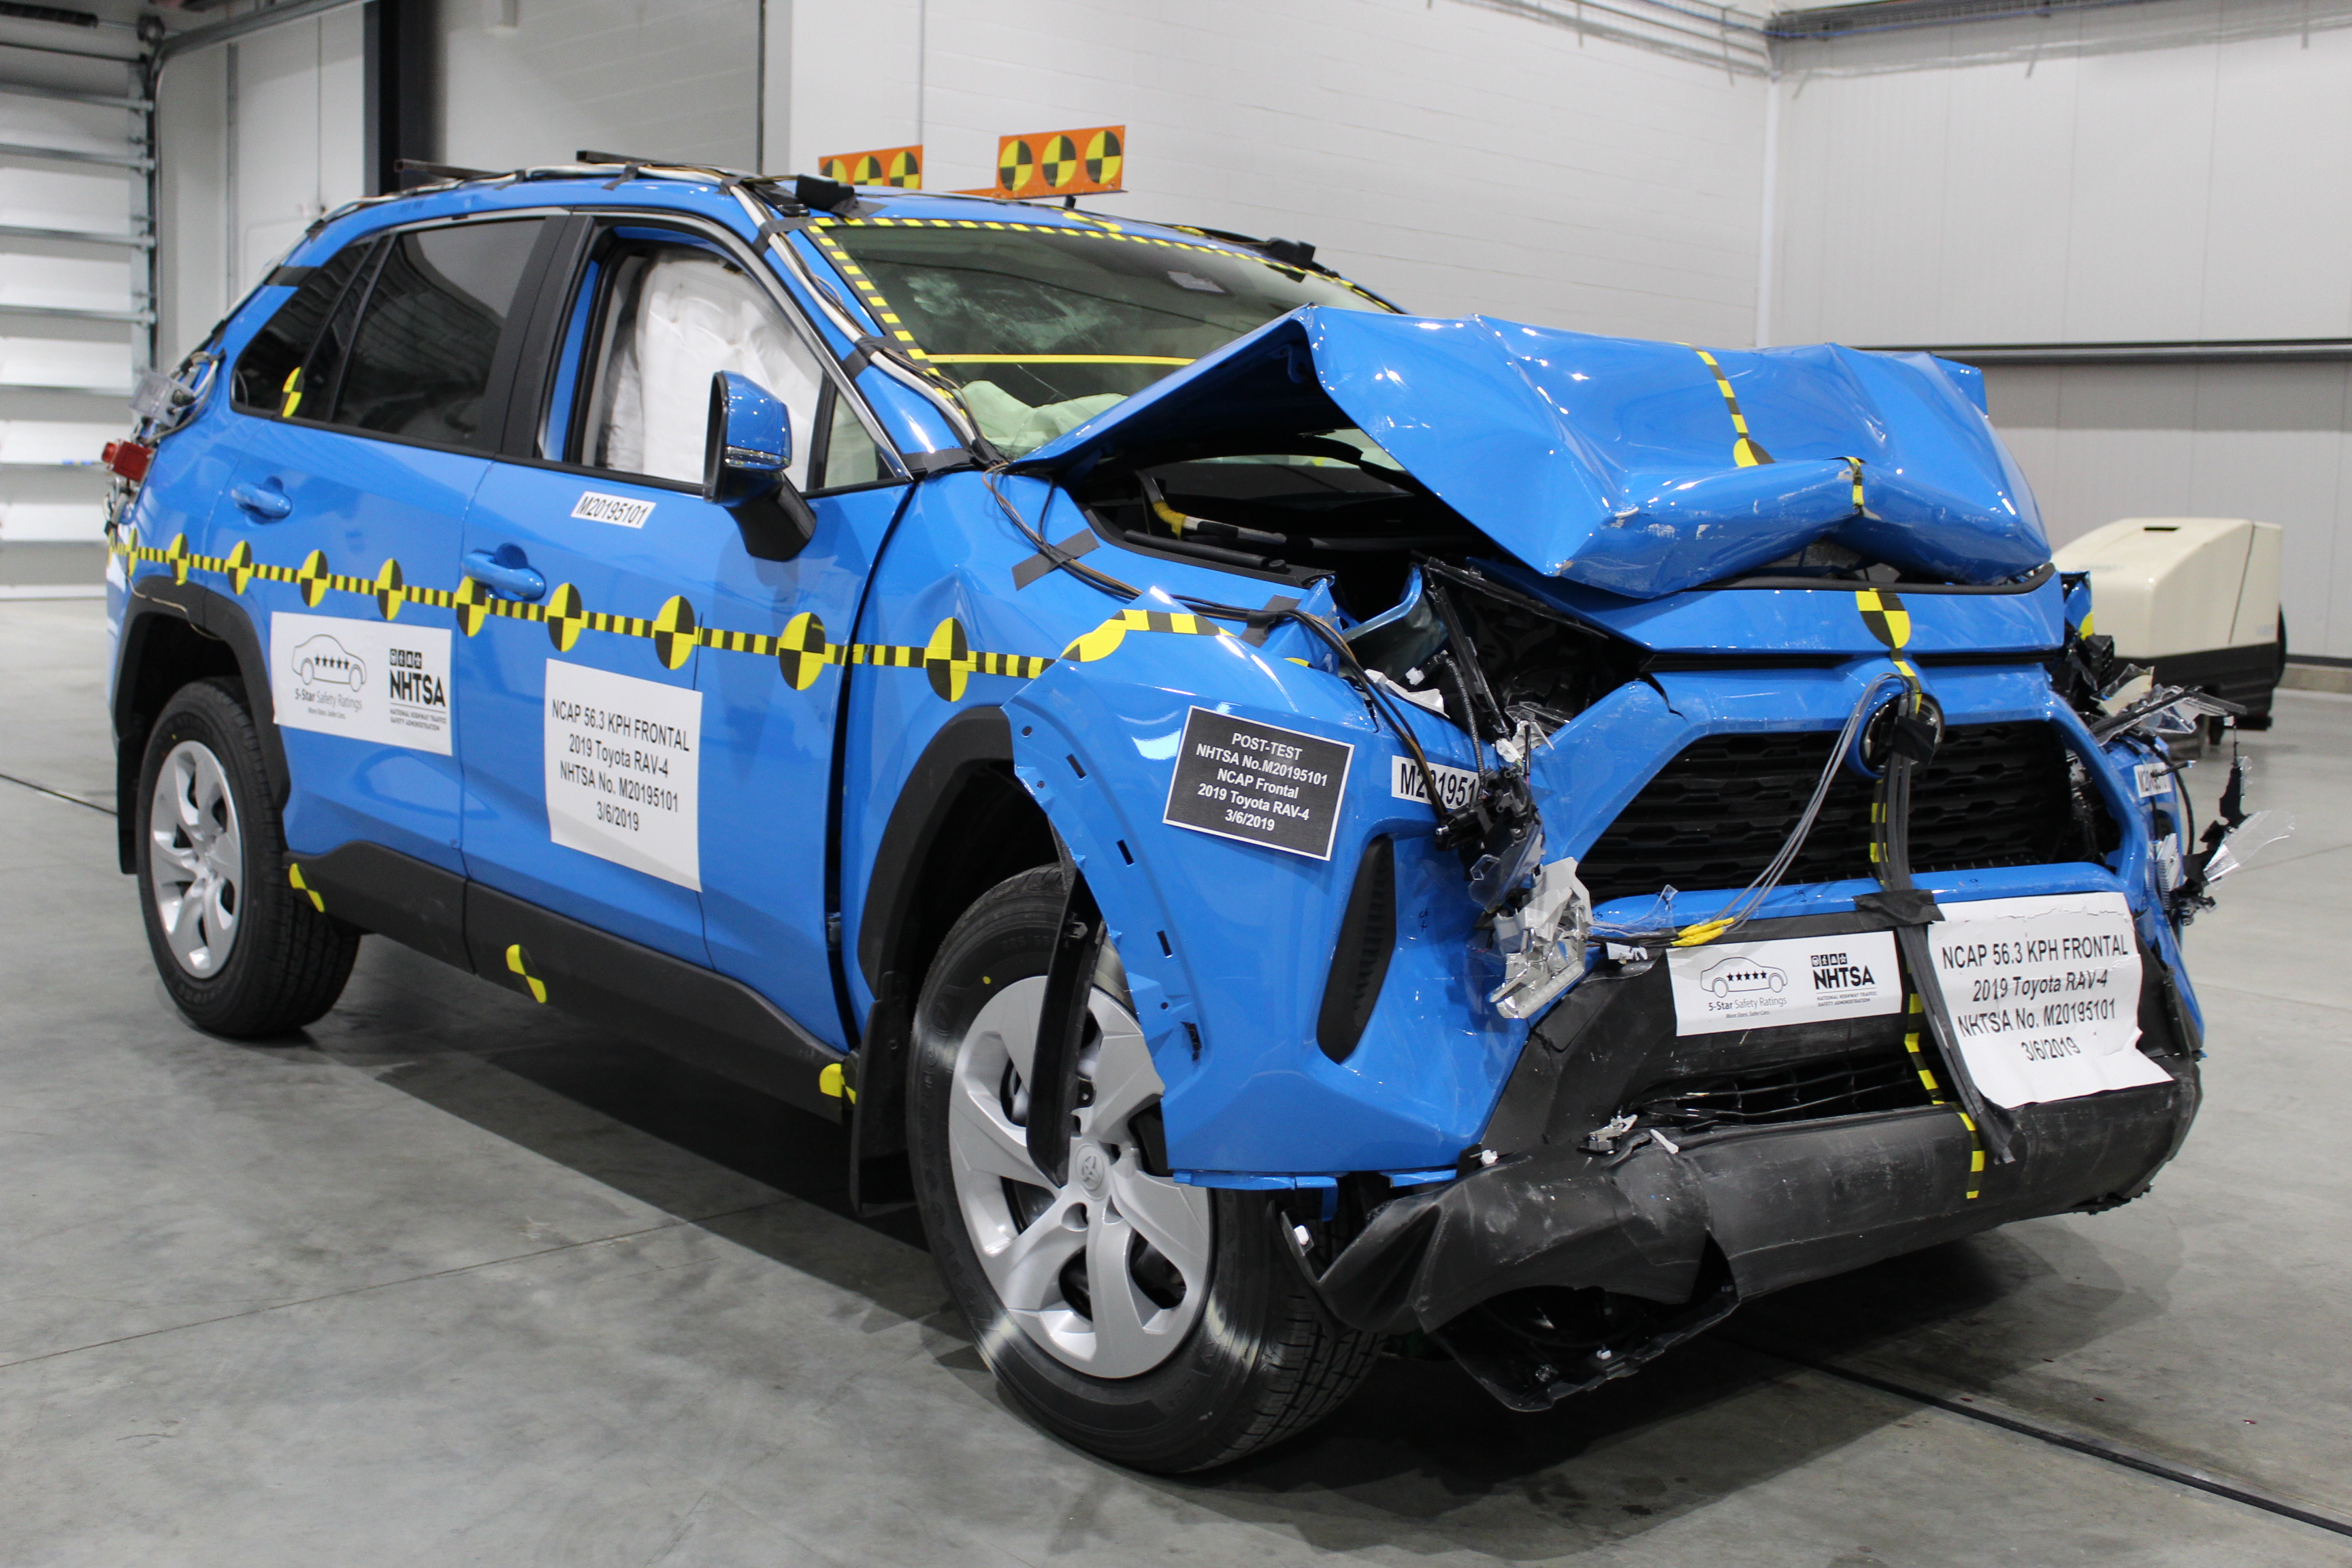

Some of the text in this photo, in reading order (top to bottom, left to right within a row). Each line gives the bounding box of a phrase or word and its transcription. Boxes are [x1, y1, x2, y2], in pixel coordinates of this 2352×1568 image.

[576, 495, 649, 525] M20195101
[295, 688, 315, 702] 5-Star
[316, 691, 336, 708] Safety
[338, 693, 362, 713] Ratings
[390, 669, 446, 707] NHTSA
[552, 698, 690, 752] NCAP 56.3 KPH FRONTAL
[569, 733, 669, 779] 2019 Toyota RAV-4
[1196, 742, 1239, 766] NHTSA
[1231, 732, 1303, 761] POST-TEST
[560, 760, 679, 813] NHTSA No. M20195101
[1216, 768, 1299, 799] NCAP Frontal
[597, 800, 640, 832] 3/6/2019
[1197, 783, 1310, 821] 2019 Toyota RAV-4
[1225, 808, 1275, 832] 3/6/2019
[1942, 934, 2128, 969] NCAP 56.3 KPH FRONTAL
[1813, 965, 1876, 990] NHTSA
[1972, 969, 2108, 1002] 2019 Toyota RAV-4
[1708, 996, 1787, 1011] 5-Star Safety Ratings
[1957, 997, 2116, 1038] NHTSA No. M20195101
[2021, 1036, 2081, 1062] 3/6/2019
